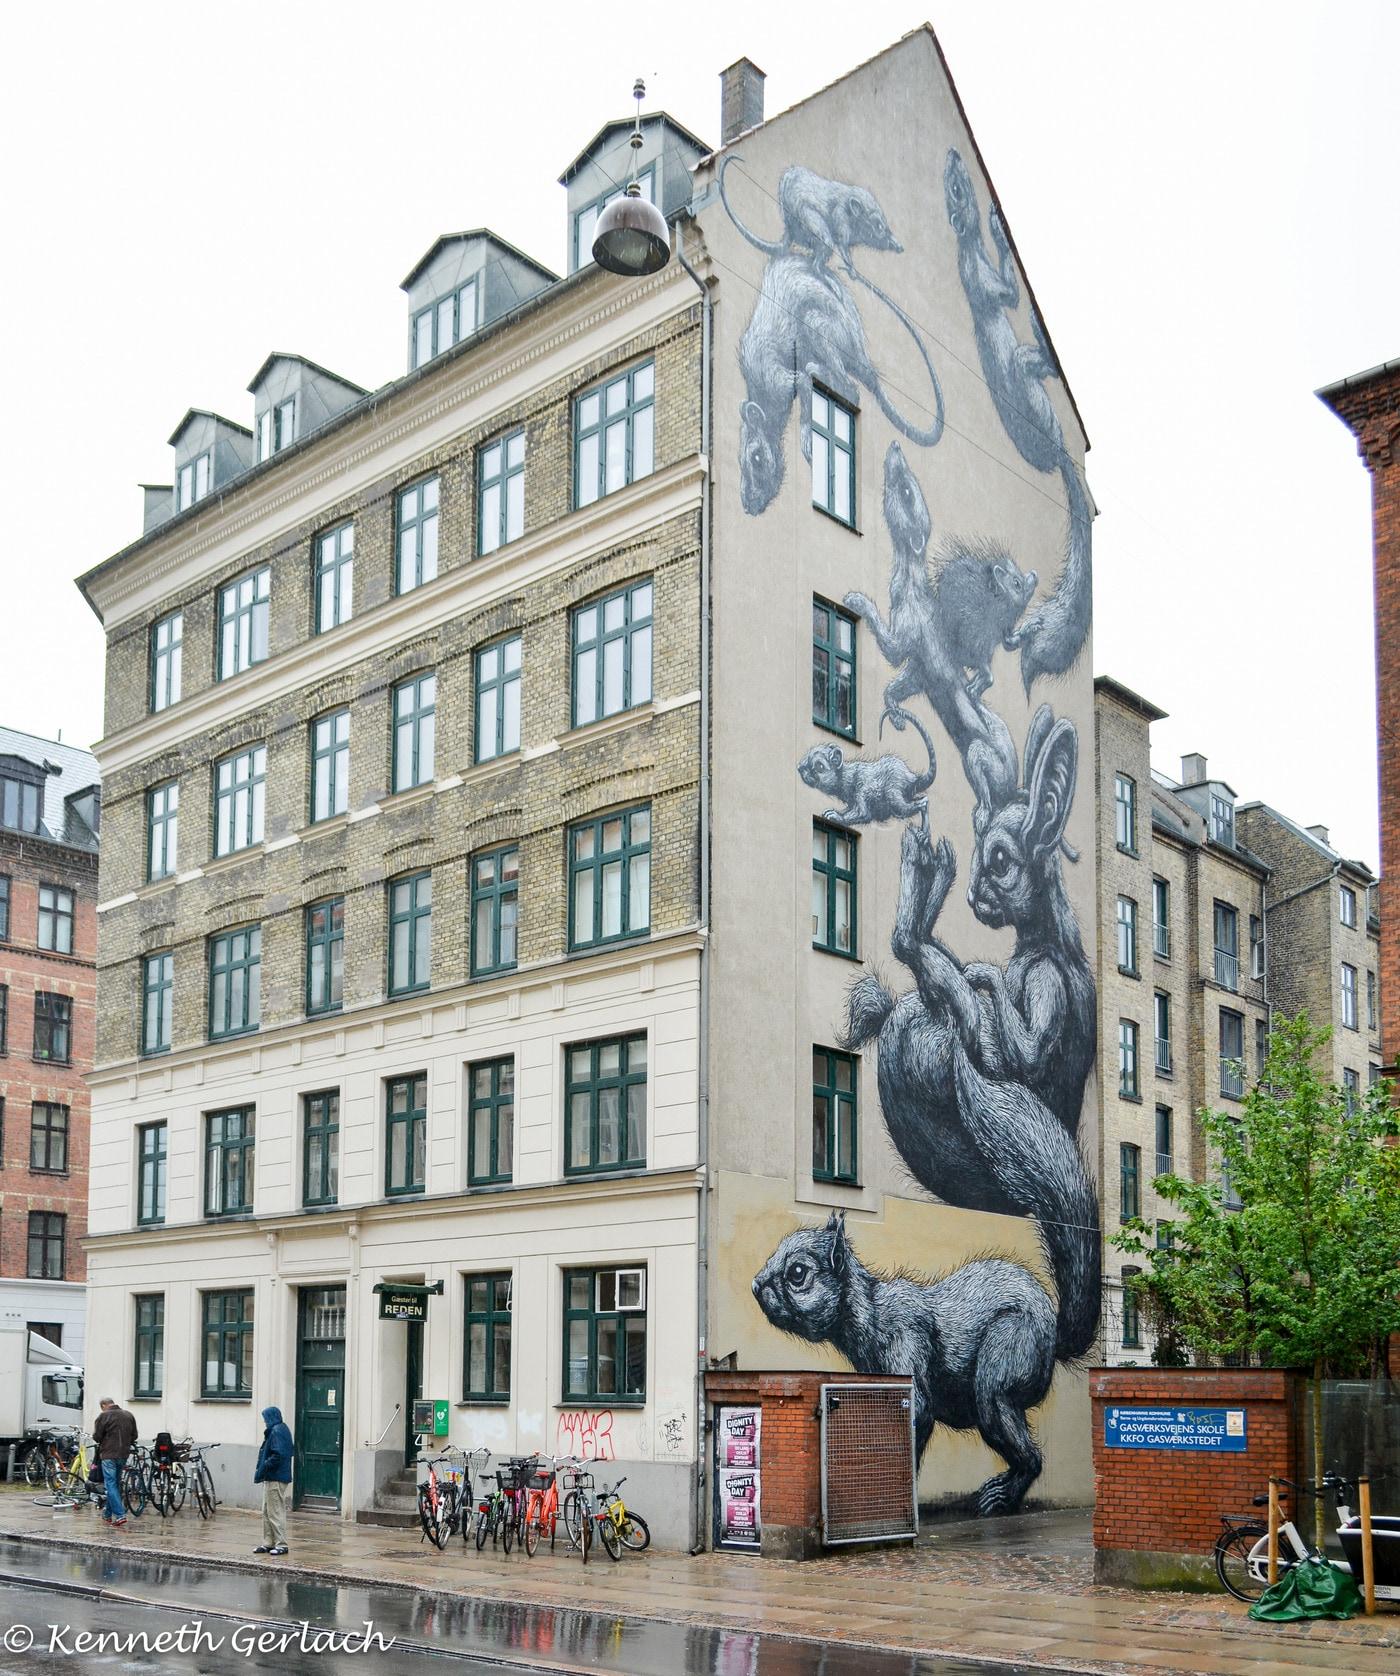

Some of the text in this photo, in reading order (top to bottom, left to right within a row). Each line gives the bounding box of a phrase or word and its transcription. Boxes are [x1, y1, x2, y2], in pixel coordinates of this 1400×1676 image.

[384, 1304, 422, 1316] REDEN
[727, 1416, 753, 1428] DIGNITY
[731, 1427, 745, 1436] DAY
[1120, 1424, 1225, 1434] GASVÆRKSVEJENS SKOLE
[1120, 1434, 1222, 1446] KKFO GASVÆRKSTEDET
[726, 1477, 753, 1488] DIGNITY
[731, 1487, 745, 1496] DAY
